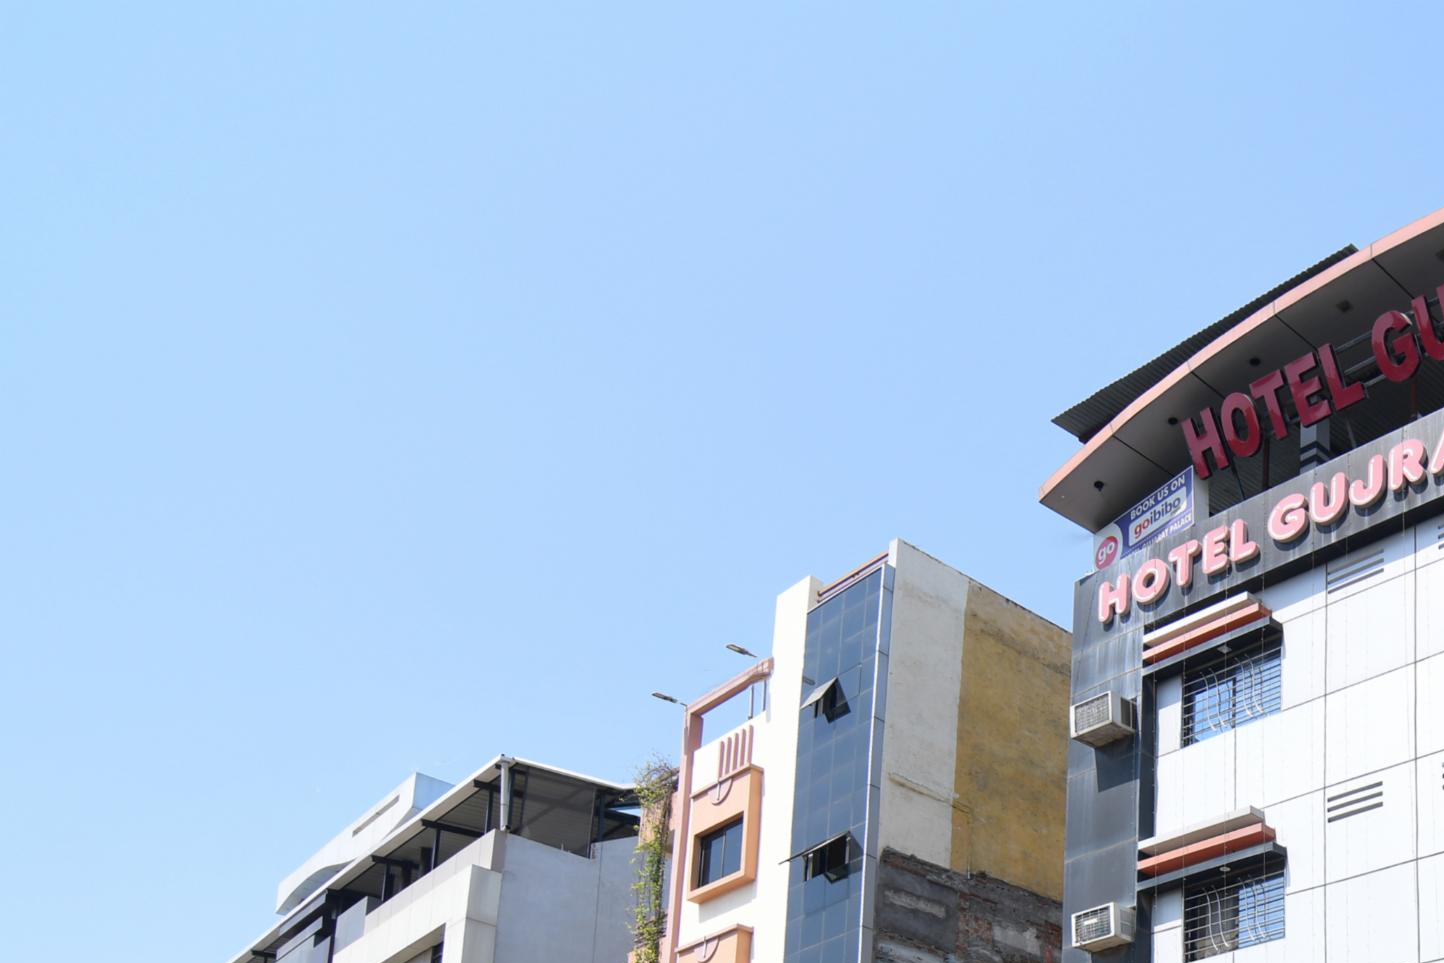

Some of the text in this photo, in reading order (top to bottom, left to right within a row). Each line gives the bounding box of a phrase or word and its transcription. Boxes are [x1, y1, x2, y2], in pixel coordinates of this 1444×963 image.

[1181, 342, 1367, 480] HOTEL
[1130, 475, 1186, 520] BOOK US ON
[1134, 497, 1181, 539] goibibo
[1098, 541, 1115, 566] go
[1098, 517, 1261, 625] HOTEL
